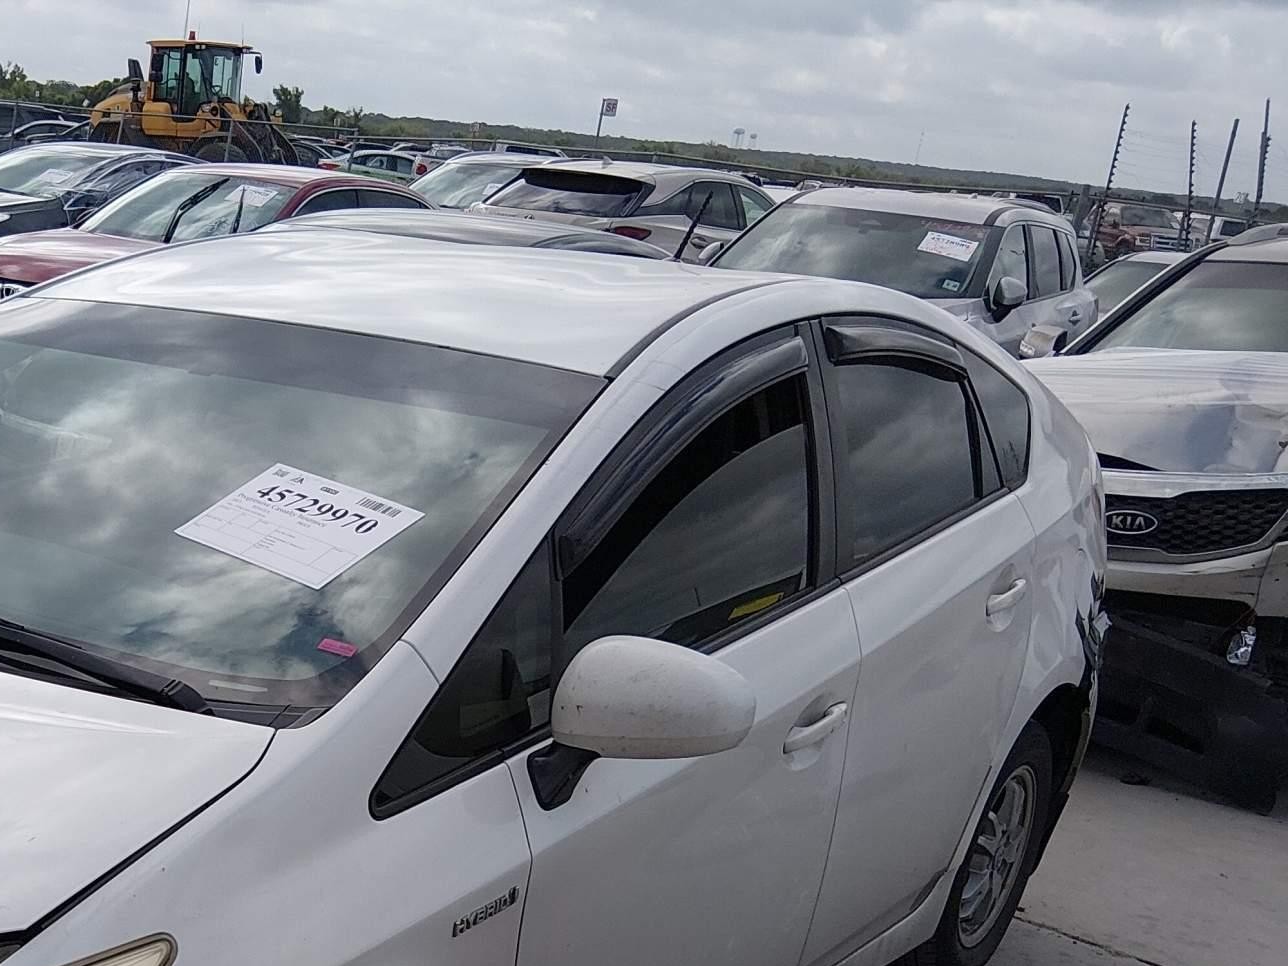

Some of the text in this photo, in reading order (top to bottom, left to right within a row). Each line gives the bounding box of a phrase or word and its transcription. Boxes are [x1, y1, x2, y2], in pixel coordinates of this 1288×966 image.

[256, 485, 379, 534] 45729970
[1111, 515, 1146, 529] KIA
[452, 890, 510, 938] HYBRID
